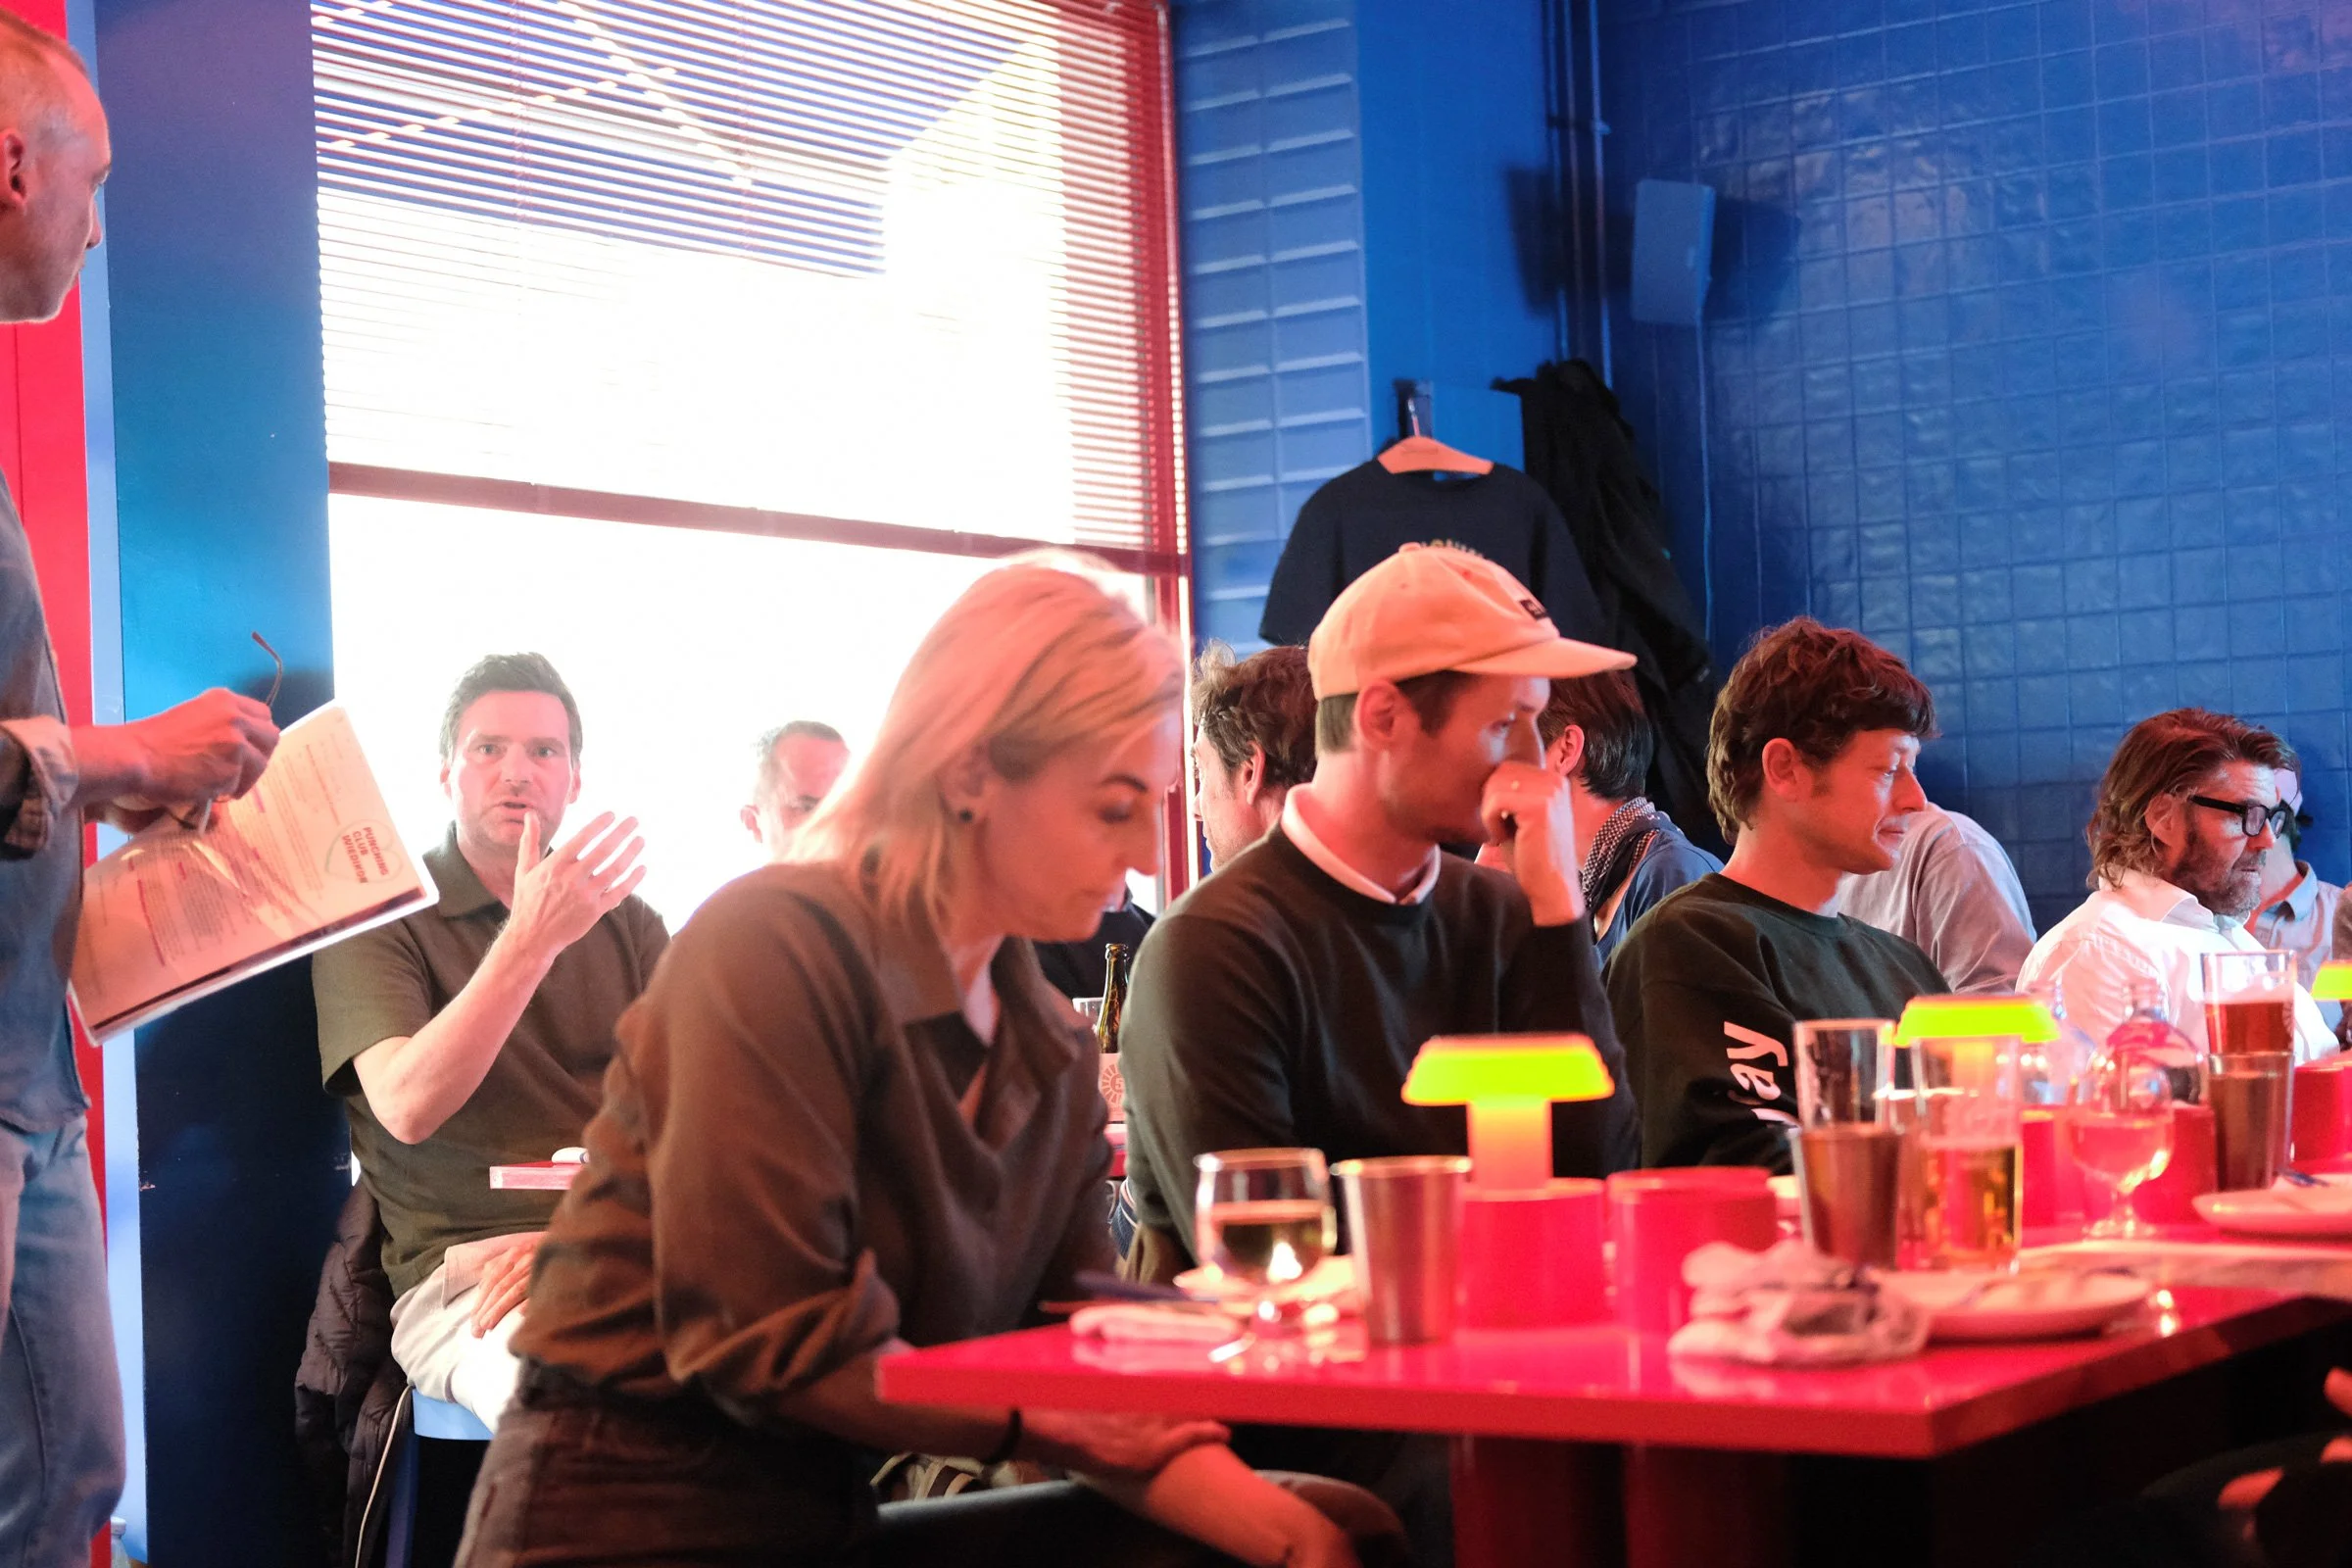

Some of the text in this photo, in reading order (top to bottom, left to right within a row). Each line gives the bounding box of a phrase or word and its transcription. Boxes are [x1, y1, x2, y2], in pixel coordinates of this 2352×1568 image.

[342, 834, 368, 883] WIEDIKON
[353, 830, 368, 856] CLUB
[363, 826, 389, 876] PUNCHING
